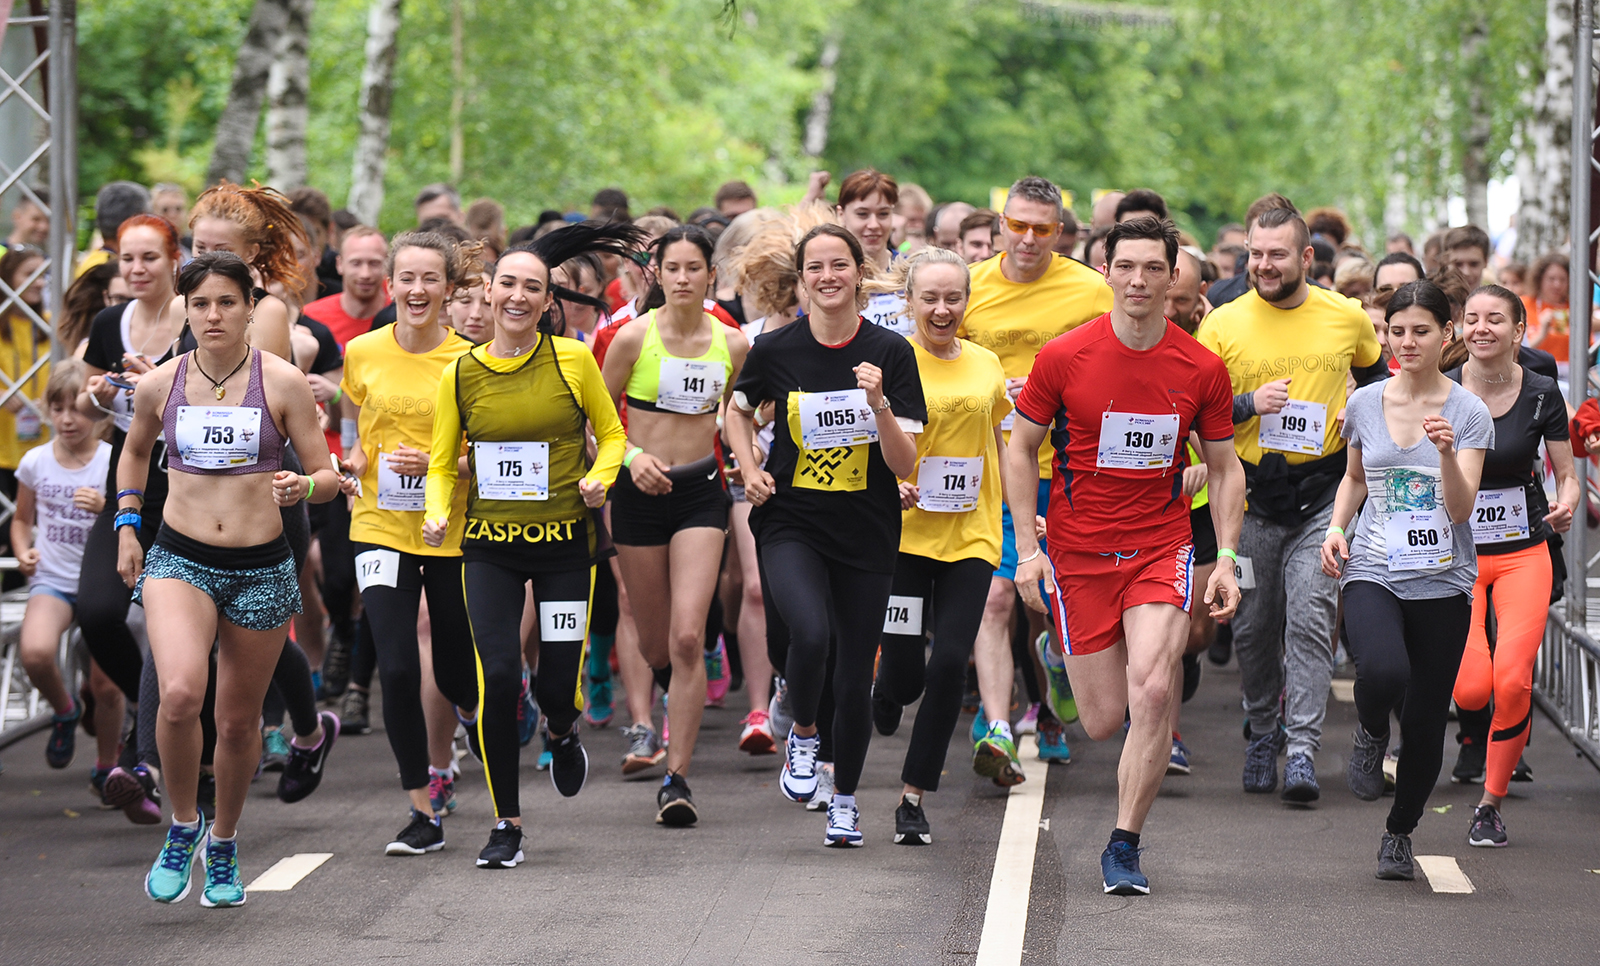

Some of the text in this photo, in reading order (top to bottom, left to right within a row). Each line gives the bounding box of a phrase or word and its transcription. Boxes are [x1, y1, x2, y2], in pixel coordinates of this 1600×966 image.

[873, 311, 899, 326] 215
[1241, 352, 1347, 379] ZASPORT
[683, 377, 705, 393] 141
[815, 408, 856, 427] 1055
[1281, 415, 1307, 433] 199
[203, 426, 235, 445] 753
[1124, 431, 1154, 449] 130
[497, 460, 522, 477] 175
[398, 474, 423, 489] 172
[943, 475, 965, 491] 174
[1476, 505, 1506, 523] 202
[464, 518, 577, 543] ZASPORT
[1407, 529, 1439, 547] 650
[361, 559, 381, 578] 172
[551, 612, 577, 630] 175
[886, 606, 909, 624] 174
